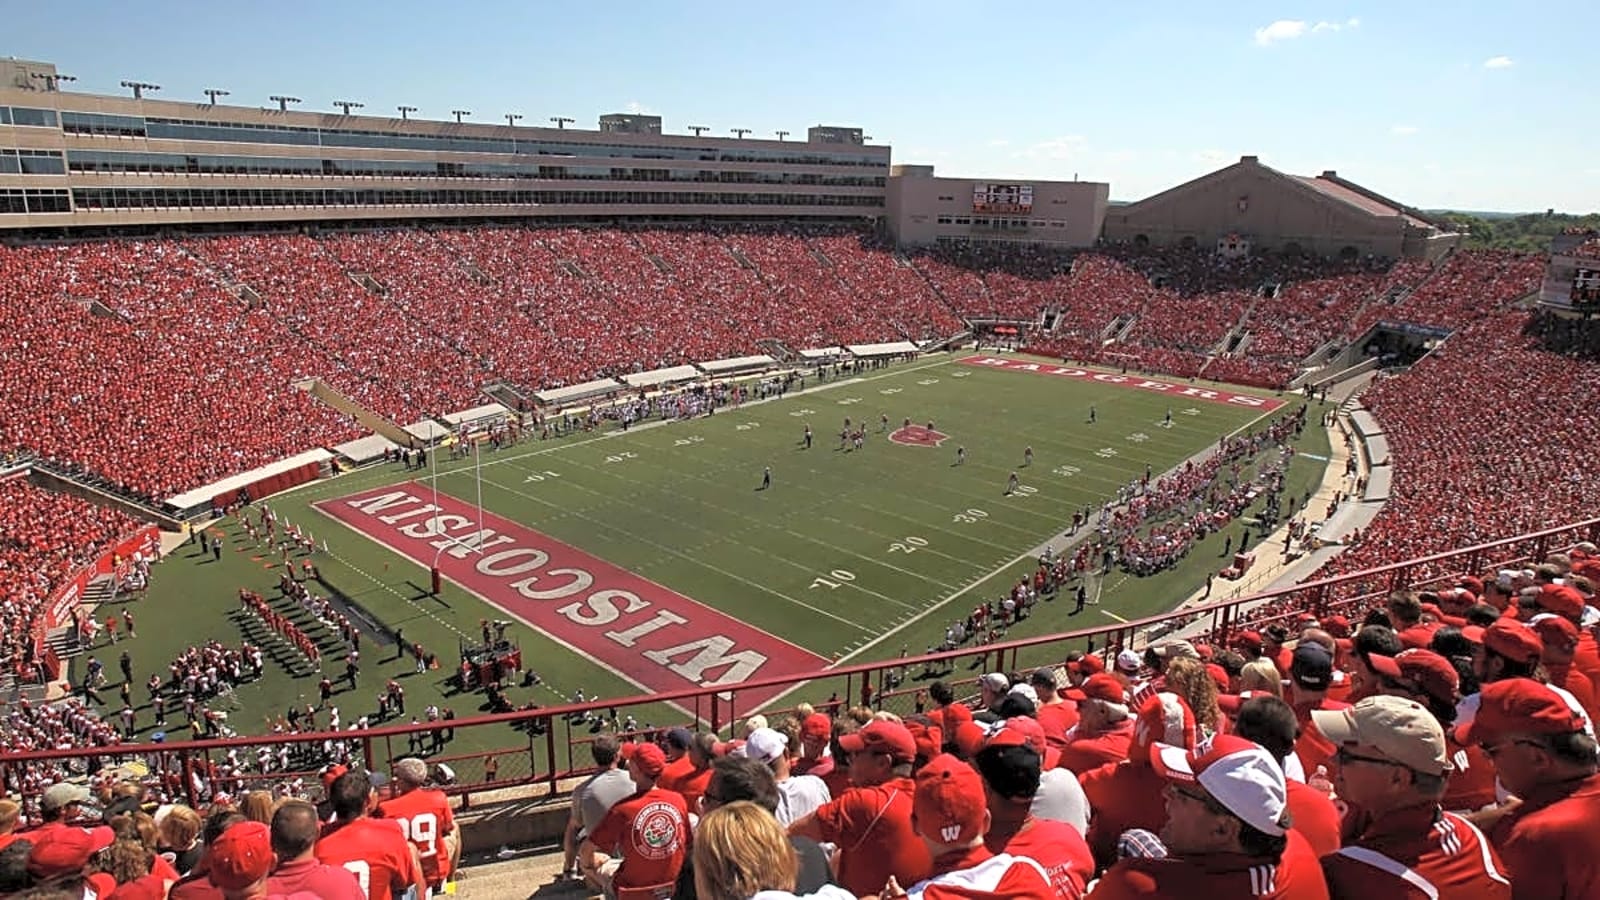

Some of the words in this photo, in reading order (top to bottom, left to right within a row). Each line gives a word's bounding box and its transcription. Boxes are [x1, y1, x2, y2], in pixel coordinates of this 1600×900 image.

[975, 357, 1267, 407] BADGERS
[606, 451, 639, 463] 20
[527, 470, 561, 482] 10
[958, 508, 989, 524] 30
[890, 536, 929, 554] 20
[814, 569, 856, 590] 10
[345, 490, 769, 701] WISCONSIN
[1454, 749, 1470, 772] W
[941, 824, 961, 842] W
